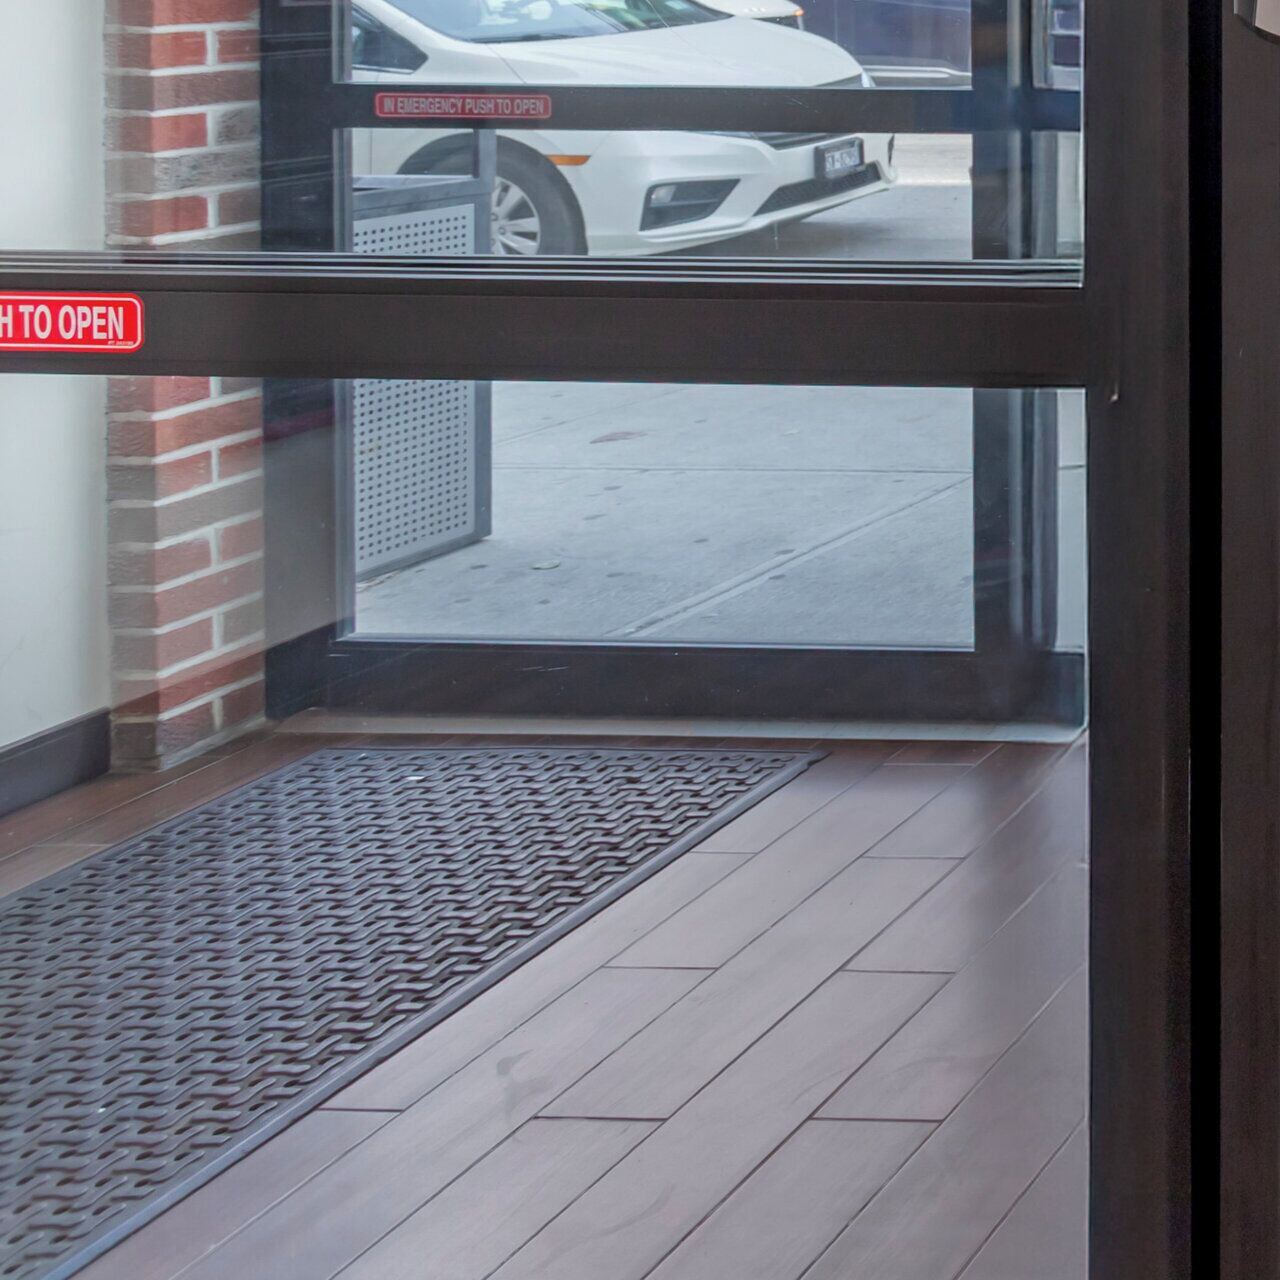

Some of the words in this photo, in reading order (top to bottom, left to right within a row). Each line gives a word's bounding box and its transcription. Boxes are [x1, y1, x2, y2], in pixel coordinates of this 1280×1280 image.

[383, 96, 395, 113] IN
[397, 97, 463, 114] EMERGENCY
[465, 98, 494, 114] PUSH
[496, 98, 511, 114] TO
[514, 99, 544, 115] OPEN
[18, 304, 52, 340] TO
[58, 305, 124, 340] OPEN
